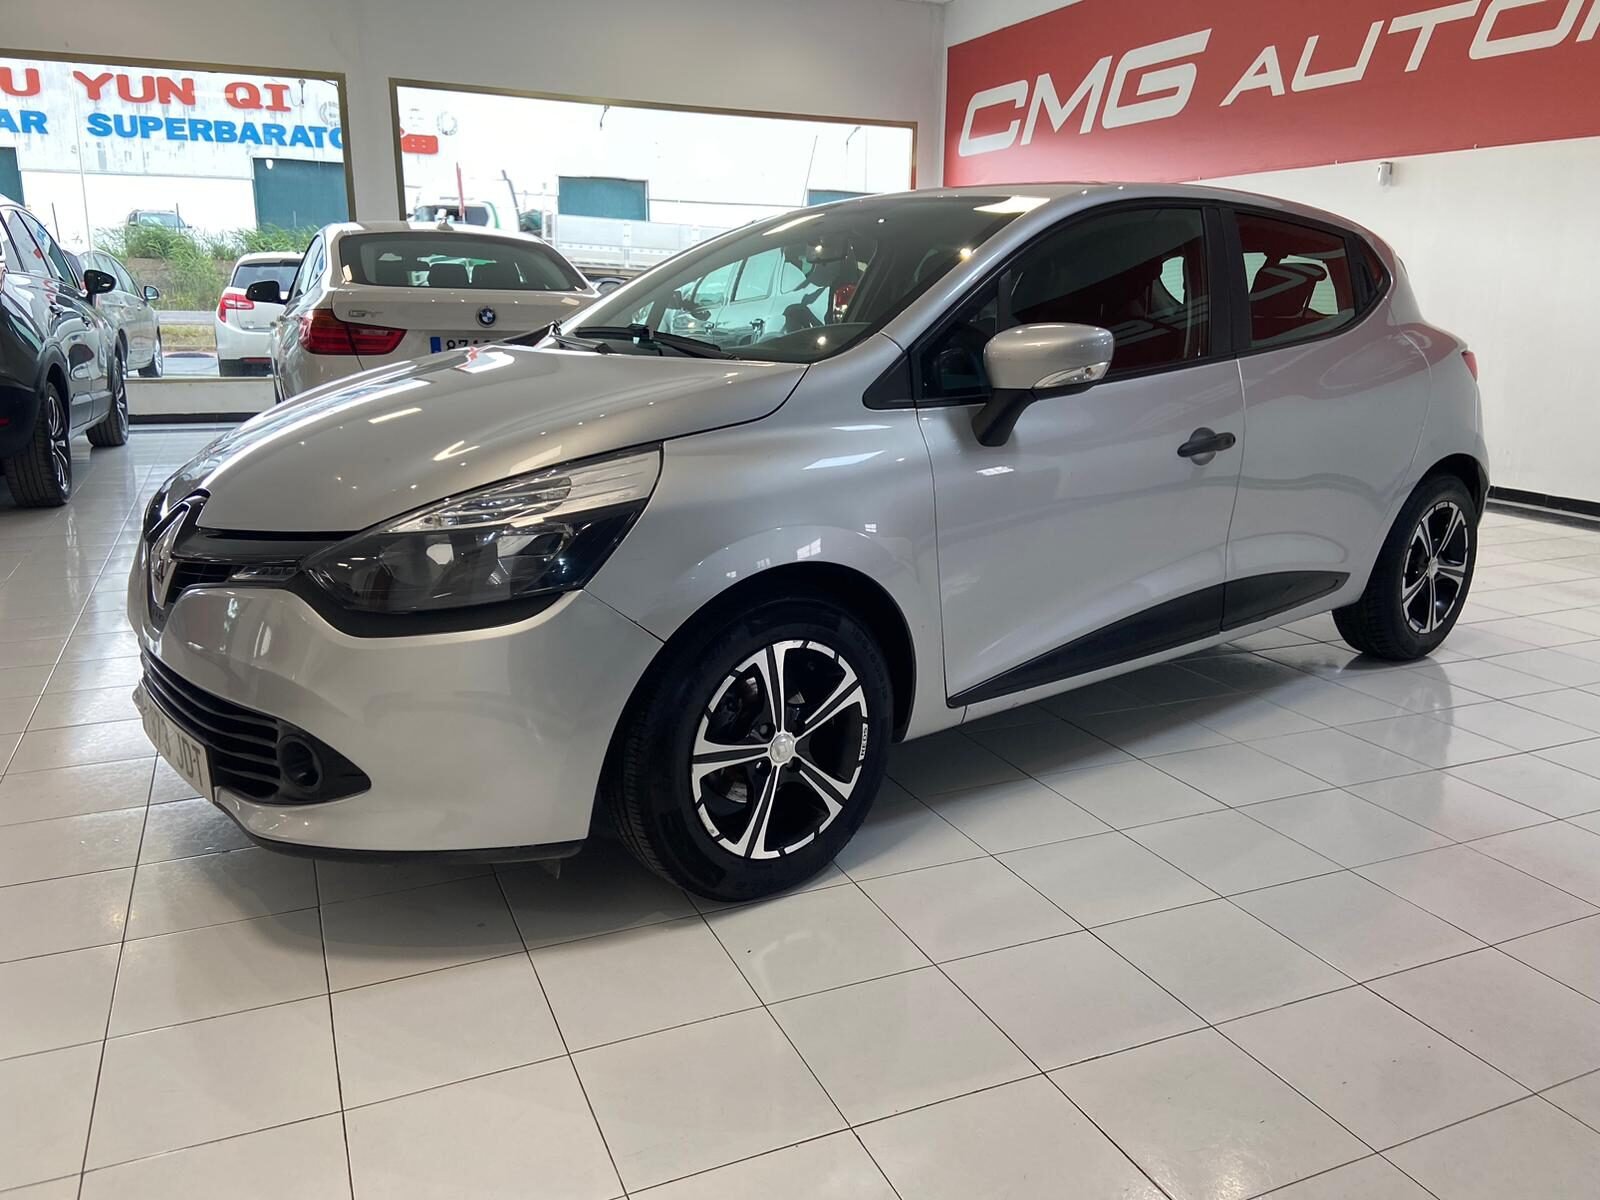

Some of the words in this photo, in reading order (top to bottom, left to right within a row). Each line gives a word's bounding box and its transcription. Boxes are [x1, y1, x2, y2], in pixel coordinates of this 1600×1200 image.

[72, 71, 196, 106] YUN
[224, 82, 292, 112] QI
[958, 28, 1213, 158] CMG
[1219, 0, 1600, 107] AUTO
